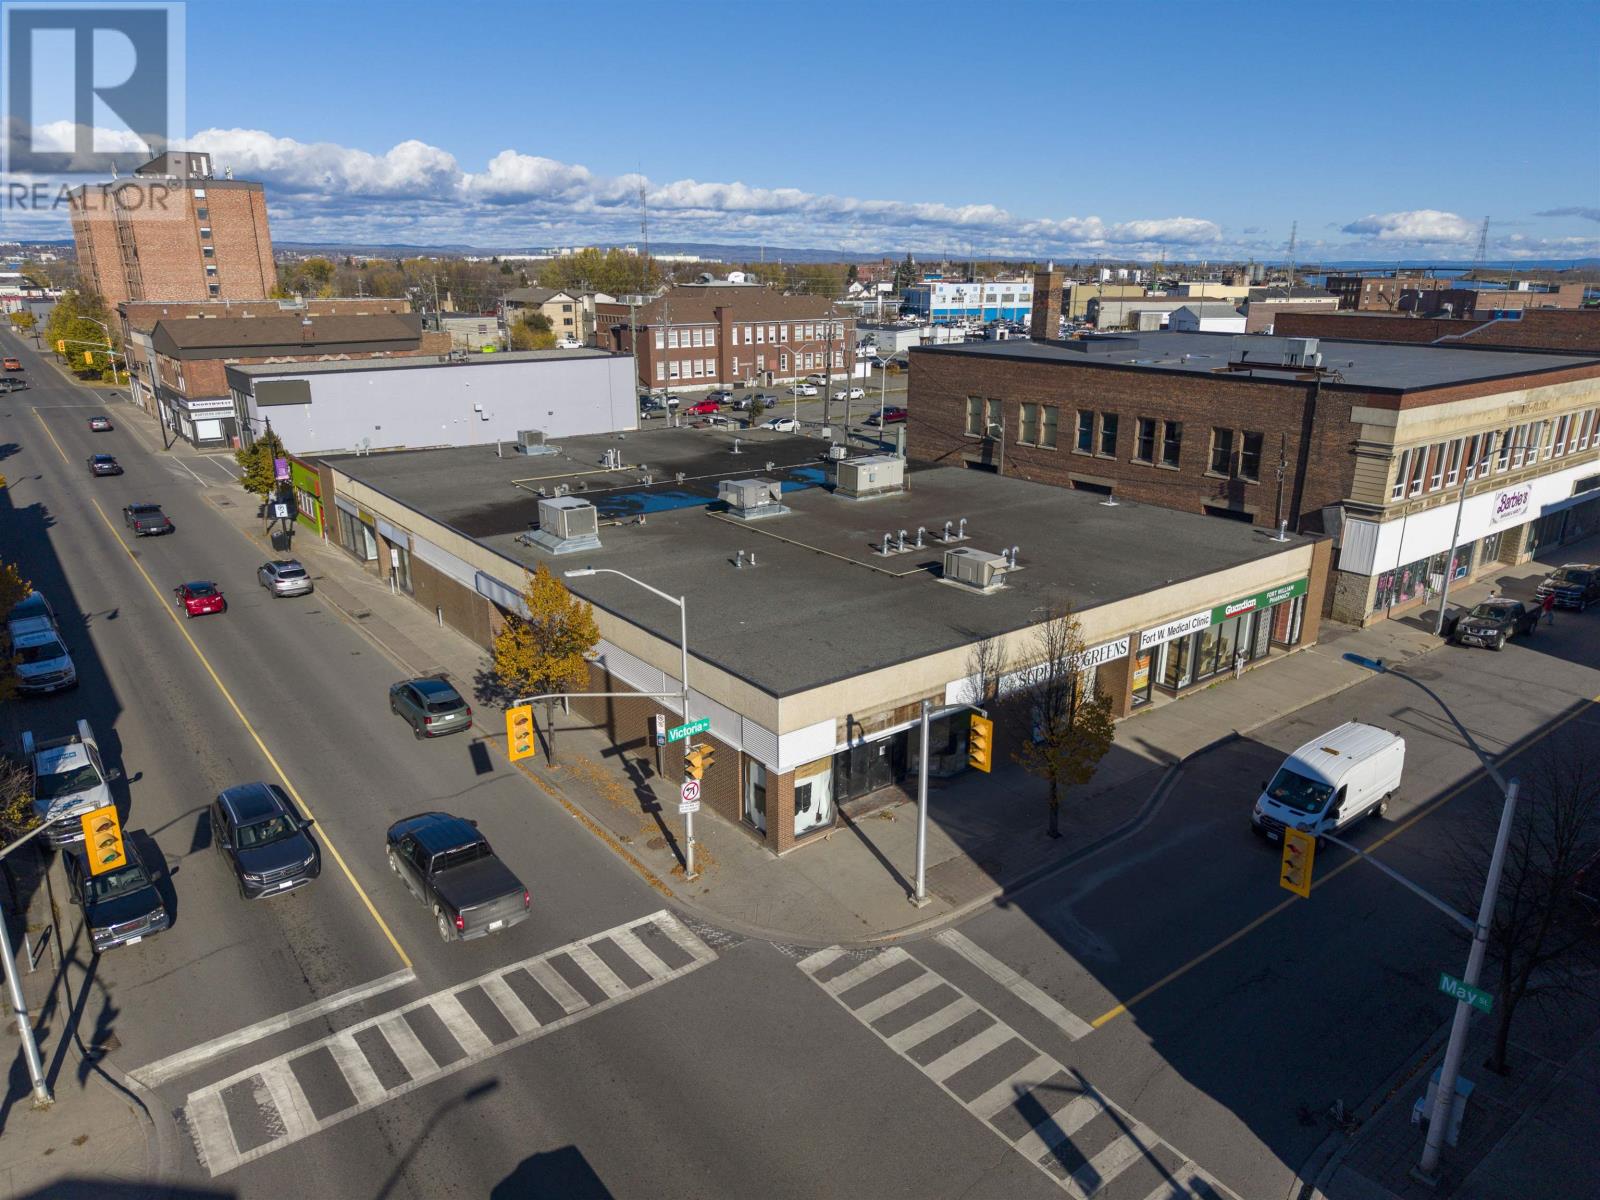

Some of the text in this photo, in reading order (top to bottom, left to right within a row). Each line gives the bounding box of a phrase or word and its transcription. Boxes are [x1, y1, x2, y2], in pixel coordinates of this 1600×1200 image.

[1225, 598, 1257, 615] Guardian
[1142, 631, 1156, 645] Fort
[1167, 620, 1191, 636] Medical
[1192, 616, 1209, 628] Clinic
[1082, 640, 1128, 666] GREENS
[670, 722, 703, 740] Victoria
[1441, 975, 1478, 1005] May
